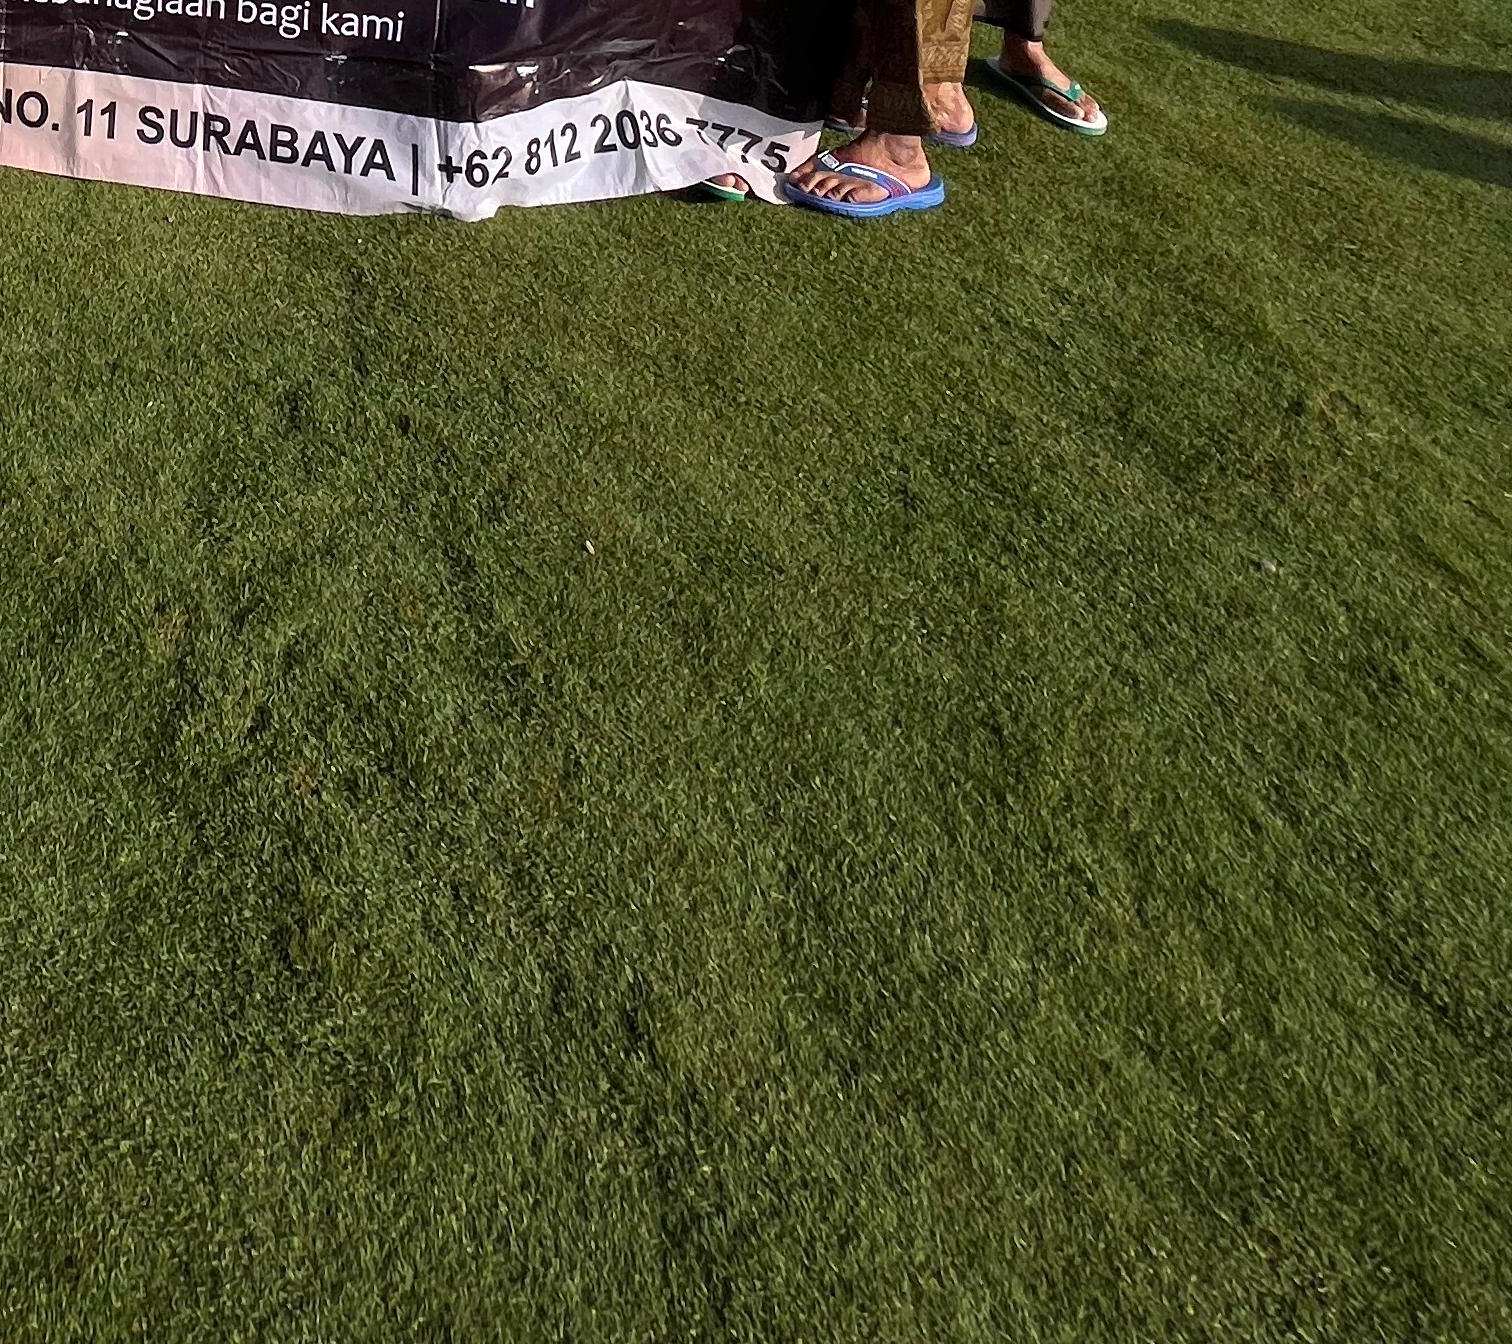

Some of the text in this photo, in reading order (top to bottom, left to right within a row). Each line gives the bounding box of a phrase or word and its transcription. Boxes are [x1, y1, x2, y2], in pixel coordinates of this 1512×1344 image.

[320, 2, 406, 43] kami
[75, 98, 119, 140] 11
[136, 104, 396, 182] SURABAYA
[437, 145, 512, 189] +62
[524, 121, 580, 176] 812
[590, 108, 684, 155] 2036
[684, 116, 791, 174] 7775
